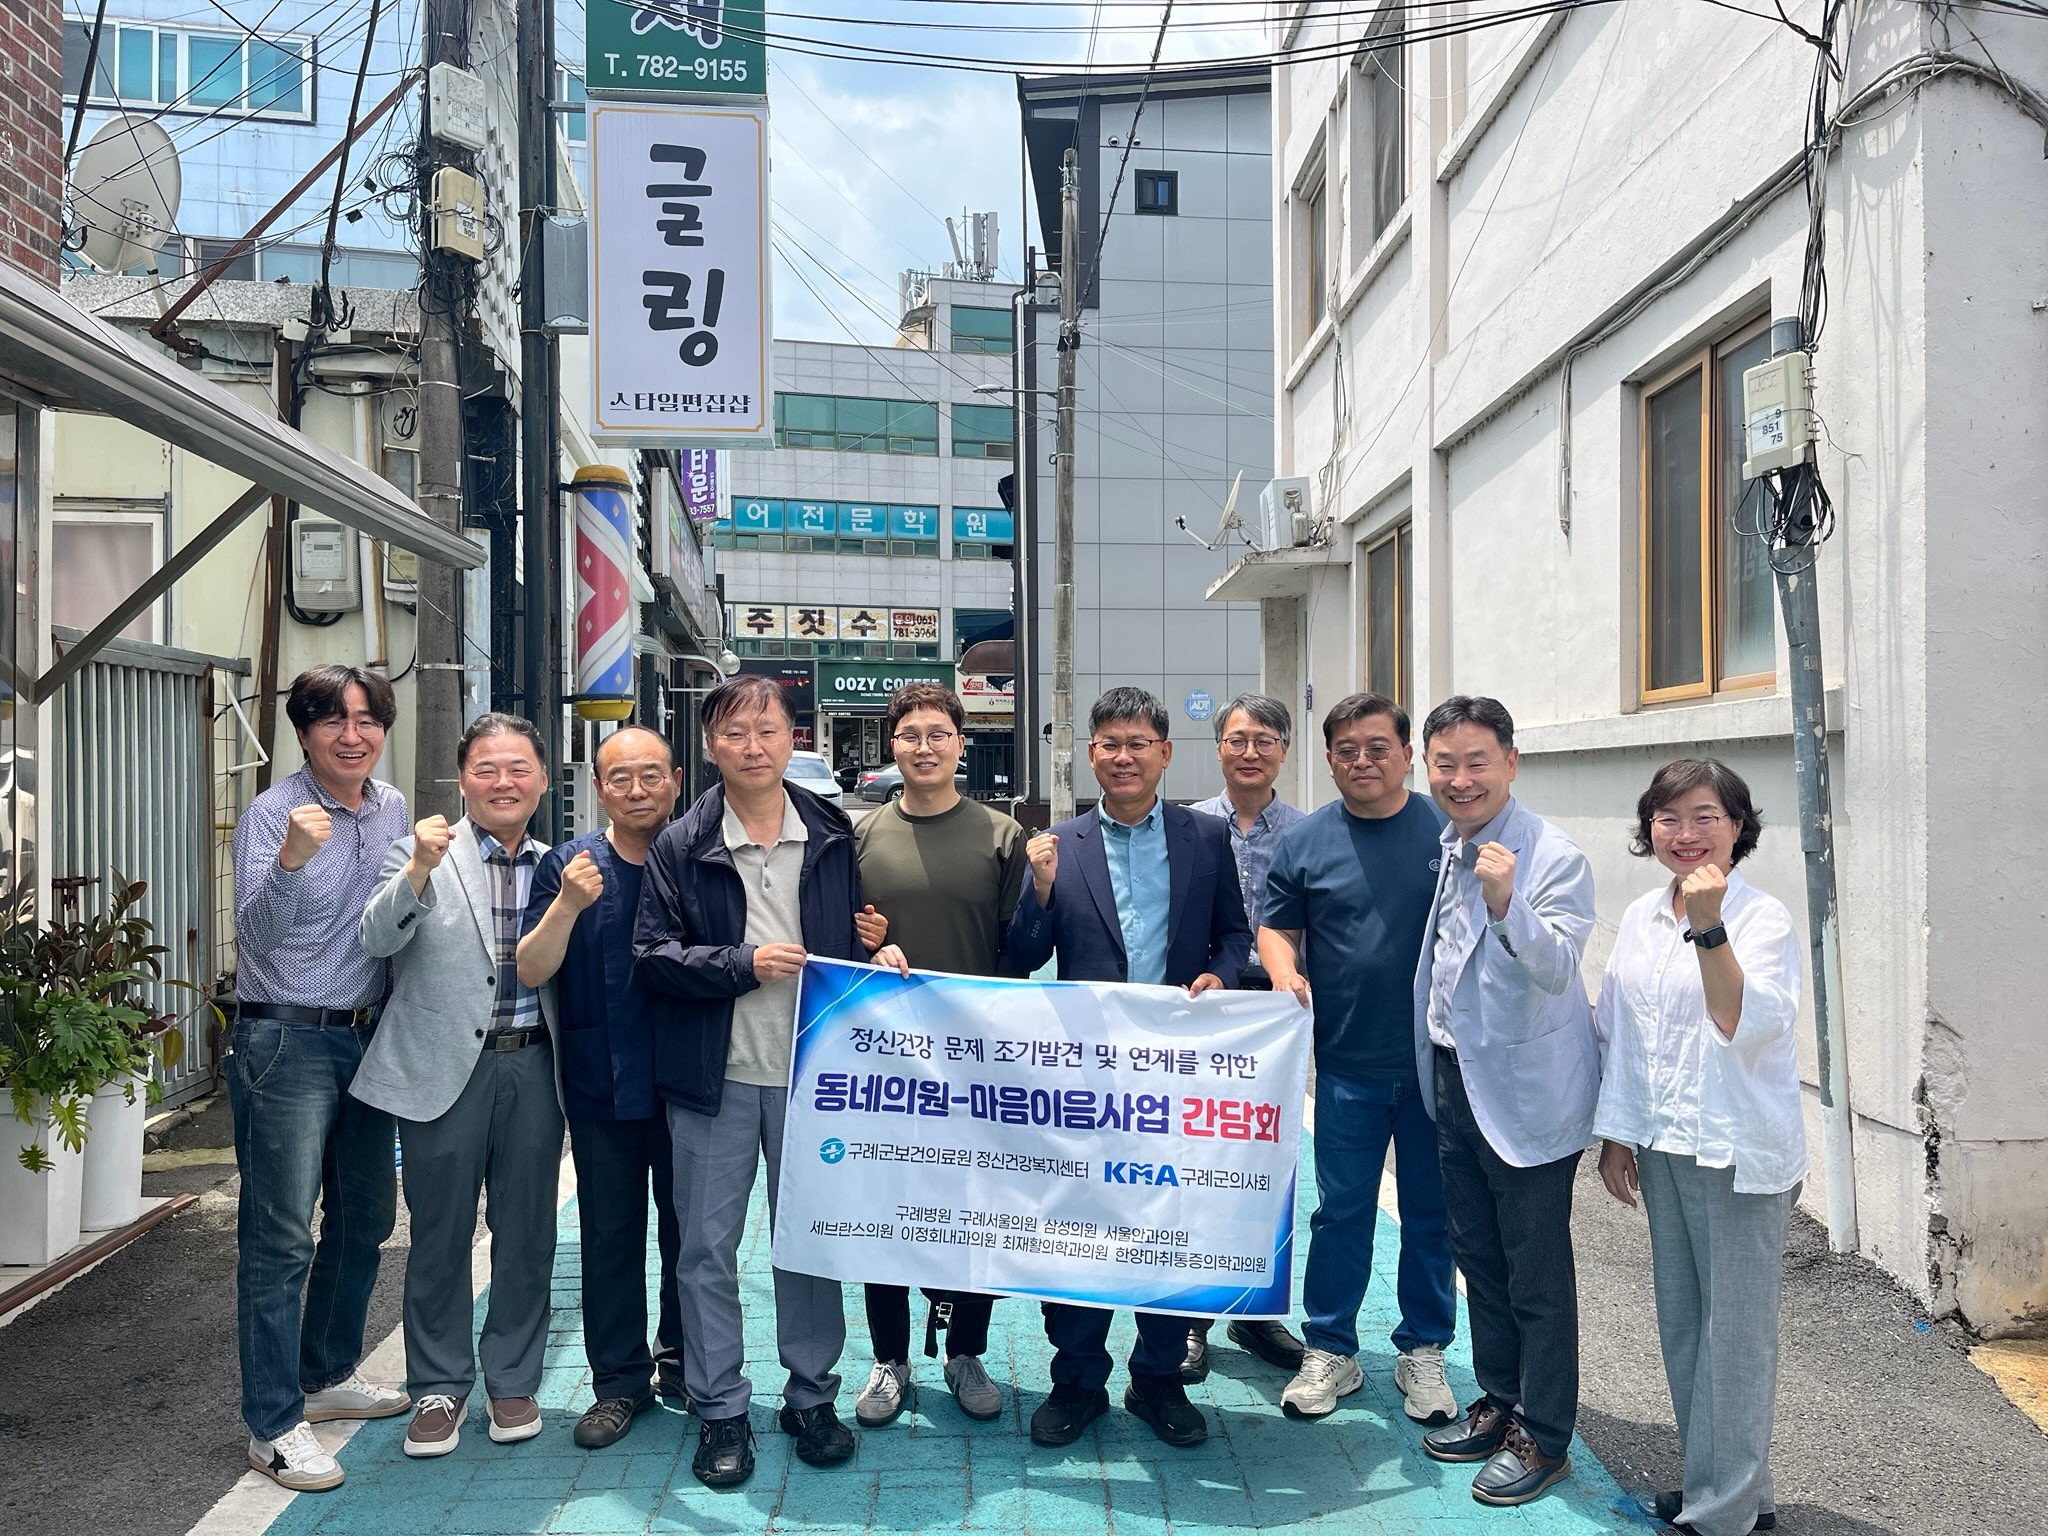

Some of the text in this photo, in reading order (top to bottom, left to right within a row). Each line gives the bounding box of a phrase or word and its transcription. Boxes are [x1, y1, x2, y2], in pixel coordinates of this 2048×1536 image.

[604, 53, 748, 82] T. 782-9155
[643, 143, 725, 367] 글링
[609, 392, 751, 414] 스타일편집샵
[1762, 421, 1780, 435] 851
[1770, 432, 1783, 445] 75
[893, 627, 937, 638] 781-3964
[895, 614, 914, 625] 문의
[834, 677, 877, 691] OOZY
[1190, 700, 1210, 711] ADT
[849, 1027, 1258, 1079] 정신건강 문제 조기발견 및 연계를 위한
[814, 1072, 1281, 1143] 동네의원-마음이음사업 간담회
[848, 1142, 1089, 1179] 구례군보건의료원 정신건강복지센터
[1104, 1161, 1270, 1192] KMA 구례군의사회
[895, 1205, 1189, 1247] 구례병원 구례서울의원 삼성의원 서울안과의원
[810, 1220, 1266, 1273] 세브란스의원 이정회내과의원 최재활의학과의원 한양마취통증의학과의원
